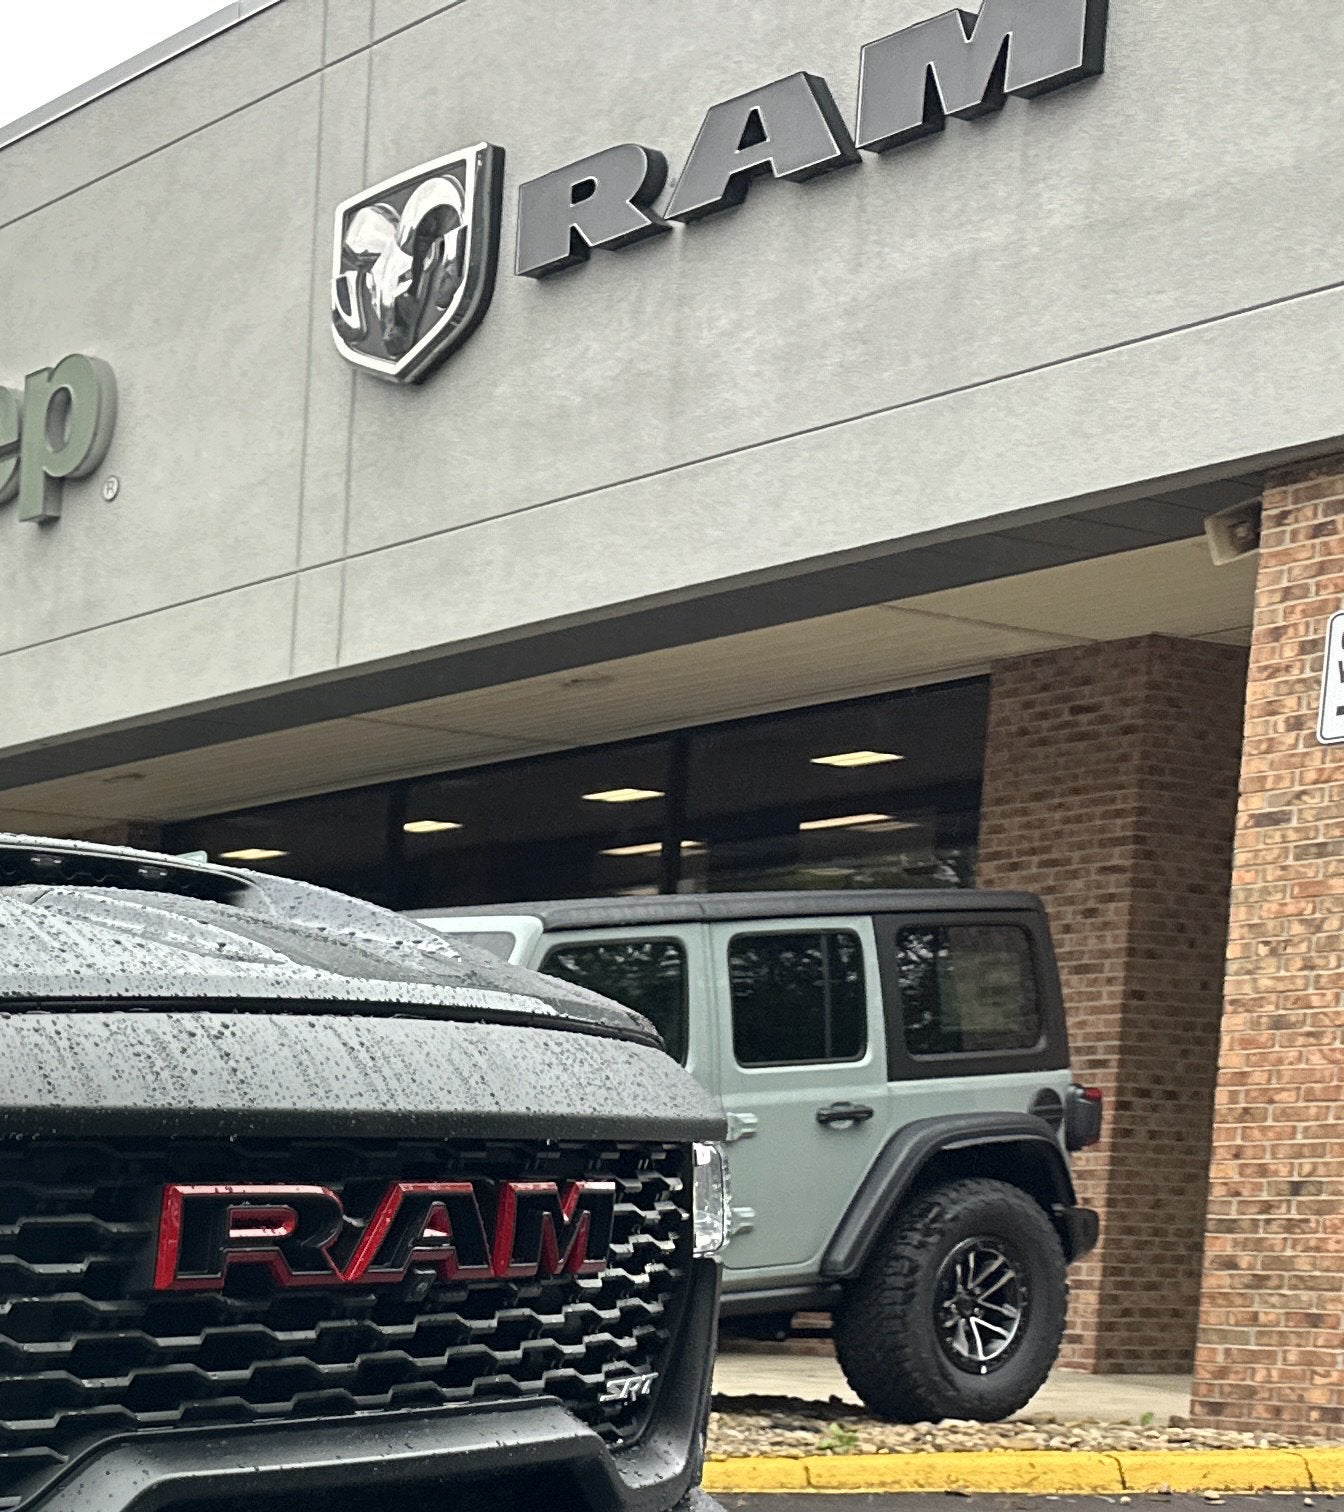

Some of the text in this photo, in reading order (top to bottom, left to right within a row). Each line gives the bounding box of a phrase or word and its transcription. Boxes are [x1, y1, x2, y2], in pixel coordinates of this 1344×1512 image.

[515, 0, 1106, 279] RAM
[154, 1181, 616, 1291] RAM
[599, 1372, 659, 1402] SRT
